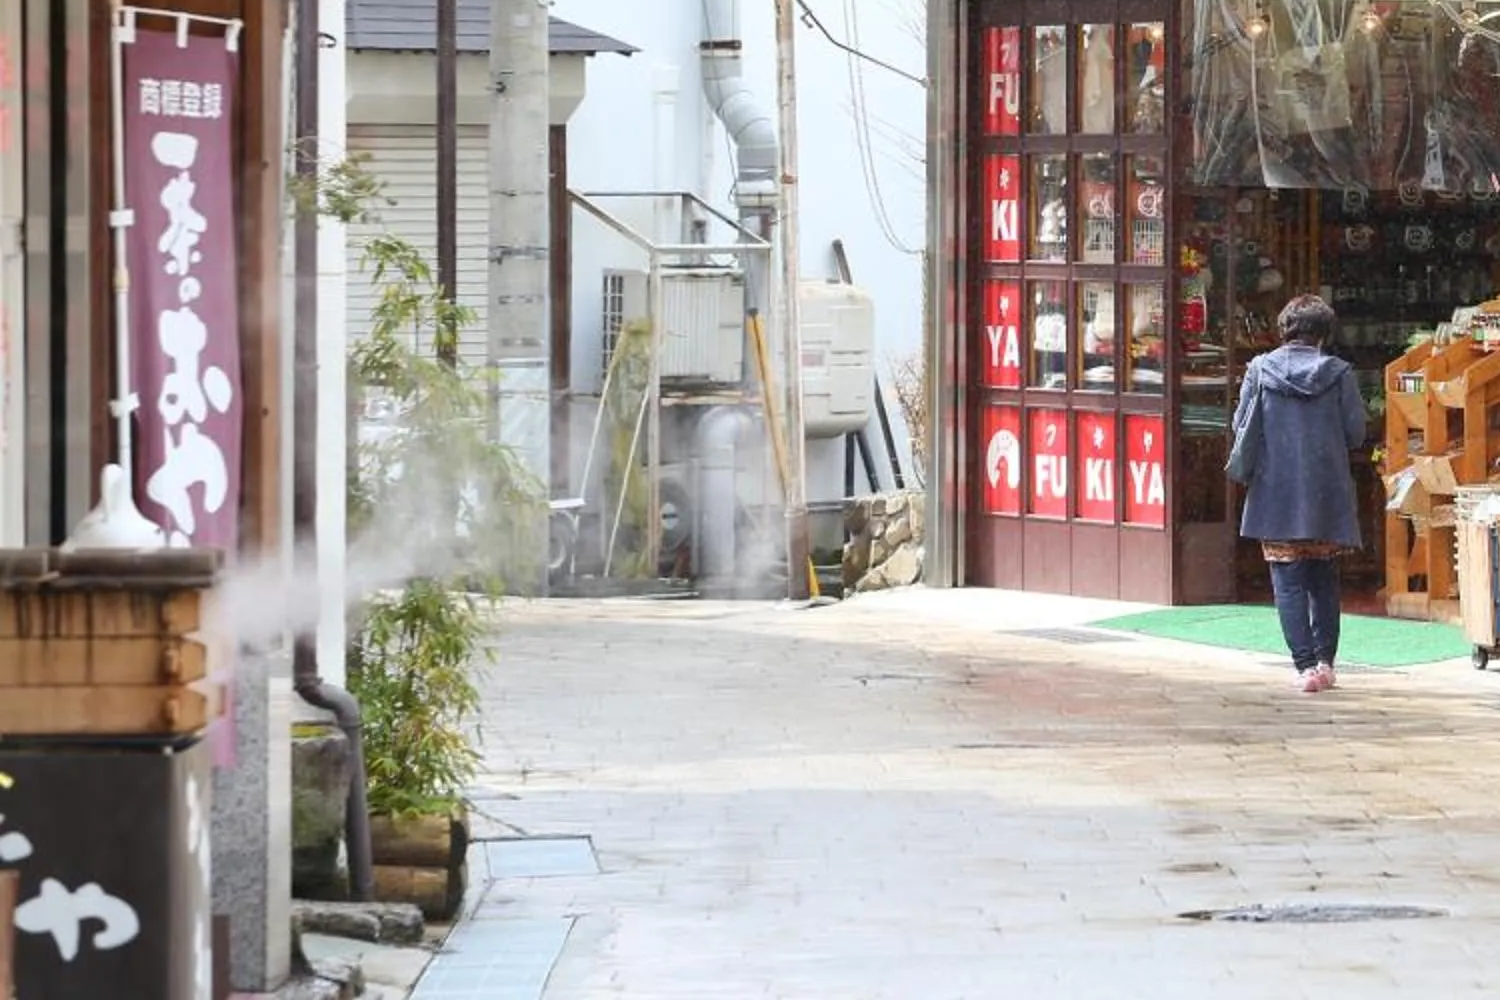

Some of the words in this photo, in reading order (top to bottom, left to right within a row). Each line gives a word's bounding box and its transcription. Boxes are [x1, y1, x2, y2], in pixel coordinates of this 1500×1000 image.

[993, 200, 1018, 241] KI
[986, 326, 1019, 367] YA
[1035, 455, 1067, 497] FU
[1086, 459, 1111, 501] KI
[1130, 461, 1164, 504] YA
